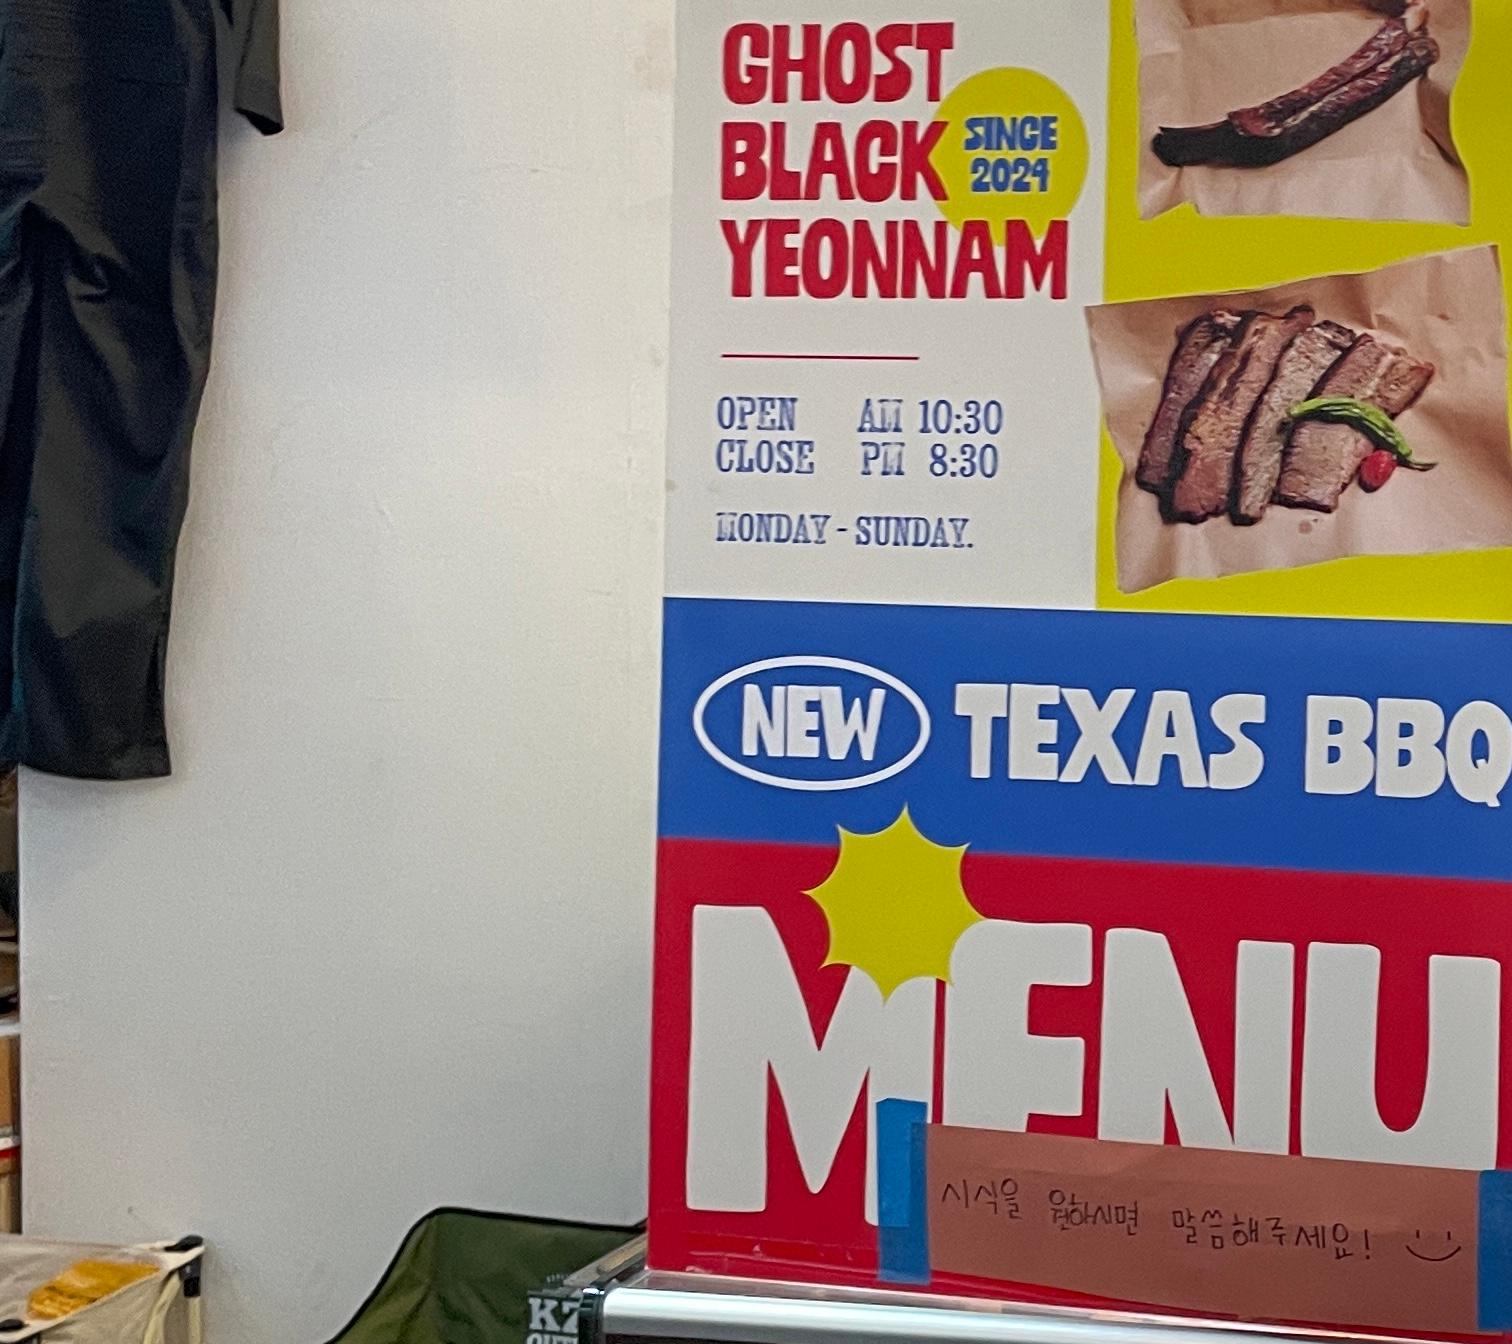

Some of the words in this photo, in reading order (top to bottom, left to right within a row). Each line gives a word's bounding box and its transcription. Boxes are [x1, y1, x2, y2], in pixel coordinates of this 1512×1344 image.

[722, 21, 954, 104] GHOST
[964, 115, 1058, 151] SINCE
[720, 120, 949, 203] BLACK
[970, 157, 1050, 193] 2024
[719, 218, 1069, 299] YEONNAM
[716, 396, 798, 432] OPEN
[857, 398, 903, 433] AM
[917, 399, 1004, 435] 10:30
[715, 439, 816, 475] CLOSE
[860, 442, 906, 476] PM
[928, 443, 1000, 478] 8:30
[715, 512, 831, 544] MONDAY
[741, 682, 887, 762] NEW
[954, 682, 1268, 791] TEXAS
[685, 902, 1502, 1229] MENU
[941, 1177, 1022, 1220] 시식을
[1049, 1188, 1138, 1236] 원하시면
